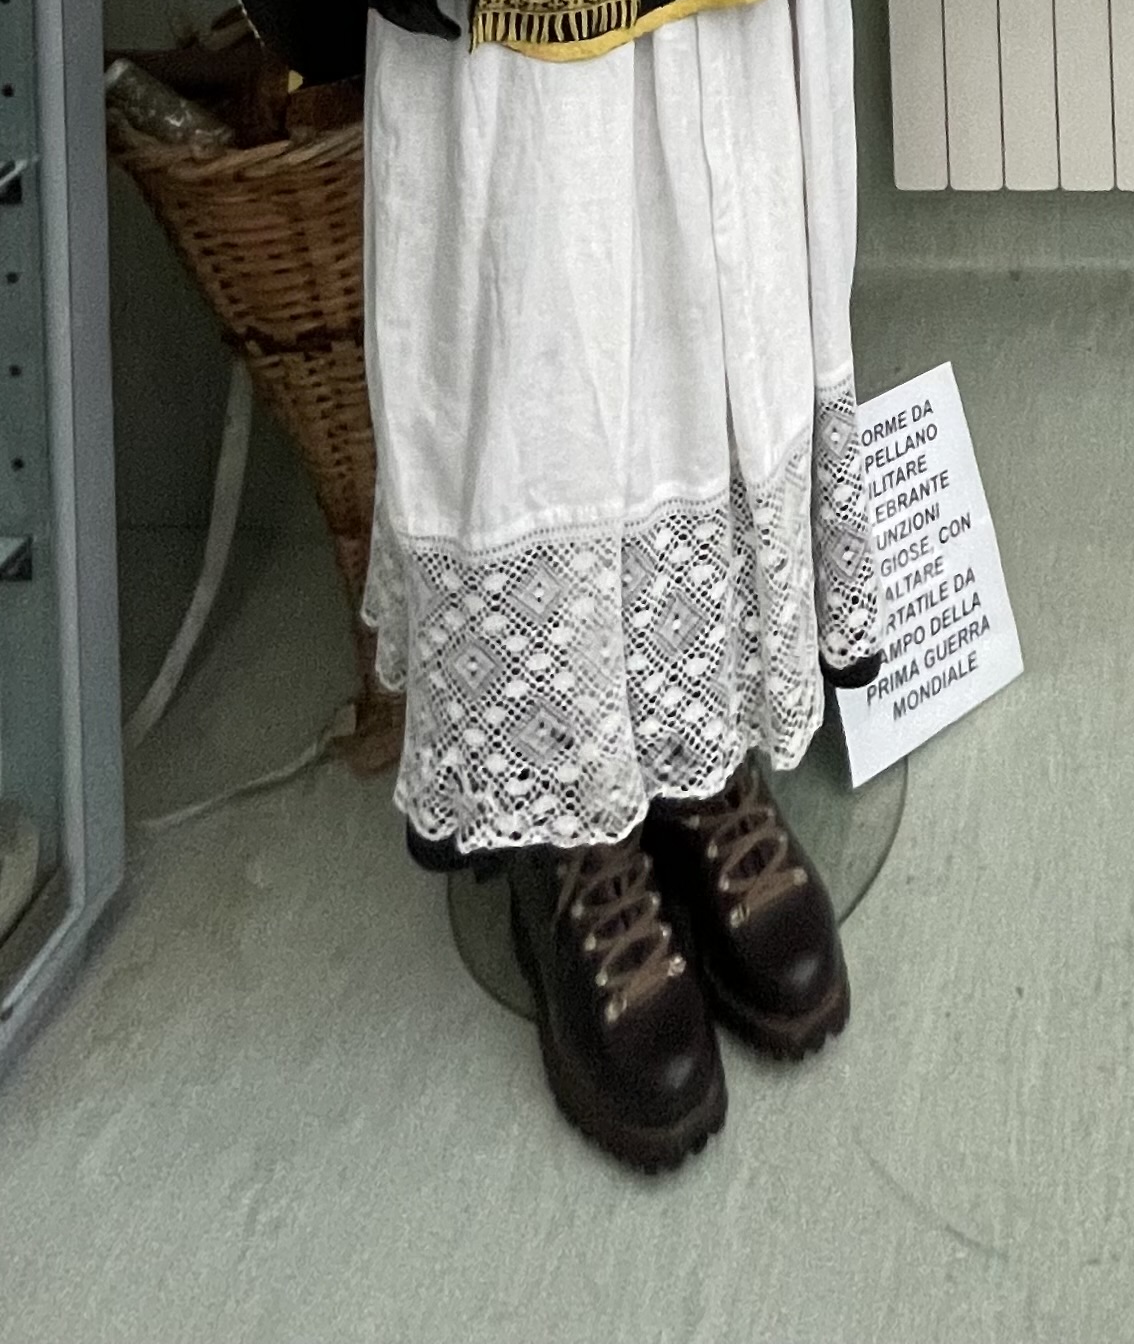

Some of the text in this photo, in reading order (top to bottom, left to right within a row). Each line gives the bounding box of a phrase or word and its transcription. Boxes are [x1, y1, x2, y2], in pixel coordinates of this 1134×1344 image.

[861, 399, 934, 447] ORME DA
[865, 423, 938, 474] PELLANO
[868, 454, 928, 500] ILITARE
[873, 469, 950, 526] EBRANTE
[876, 502, 941, 551] UNZIONI
[881, 512, 972, 578] GIOSE, CON
[885, 555, 945, 602] ALTARE
[886, 567, 976, 635] RTATILE DA
[879, 591, 982, 664] AMPO DELLA
[866, 614, 991, 707] PRIMA GUERRA
[893, 650, 979, 721] MONDIALE
